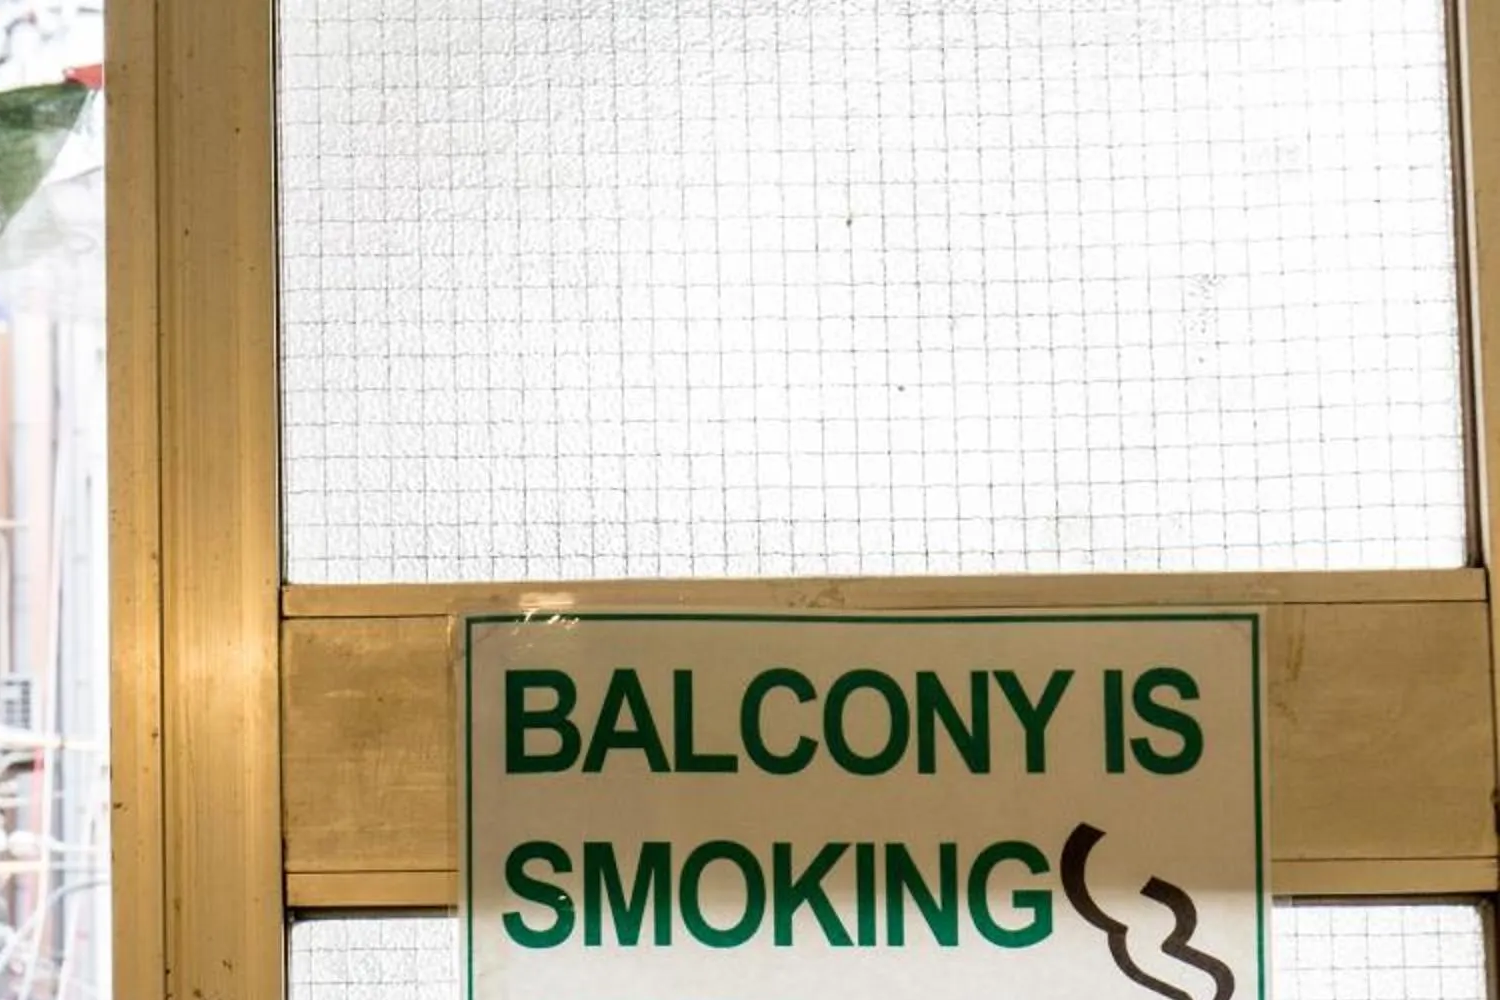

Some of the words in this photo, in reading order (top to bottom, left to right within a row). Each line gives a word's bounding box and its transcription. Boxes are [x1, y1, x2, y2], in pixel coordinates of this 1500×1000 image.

[504, 666, 1074, 776] BALCONY
[1104, 667, 1204, 776] IS
[502, 839, 1053, 948] SMOKING
